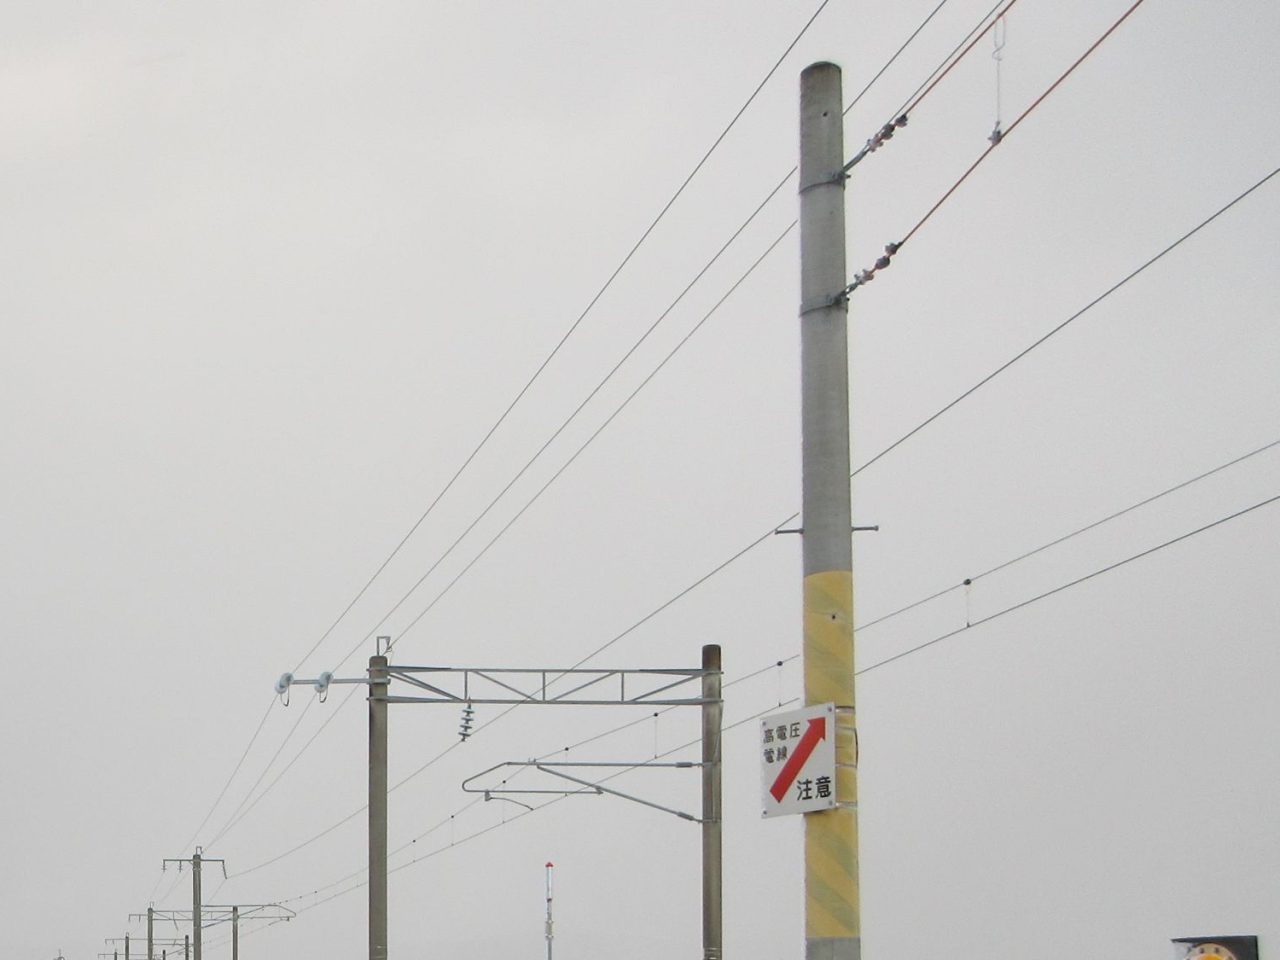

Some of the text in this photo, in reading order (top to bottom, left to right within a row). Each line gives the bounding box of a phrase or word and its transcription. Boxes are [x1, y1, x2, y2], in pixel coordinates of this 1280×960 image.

[763, 722, 801, 744] 高電圧
[763, 746, 788, 763] 電線
[796, 776, 832, 801] 注意
